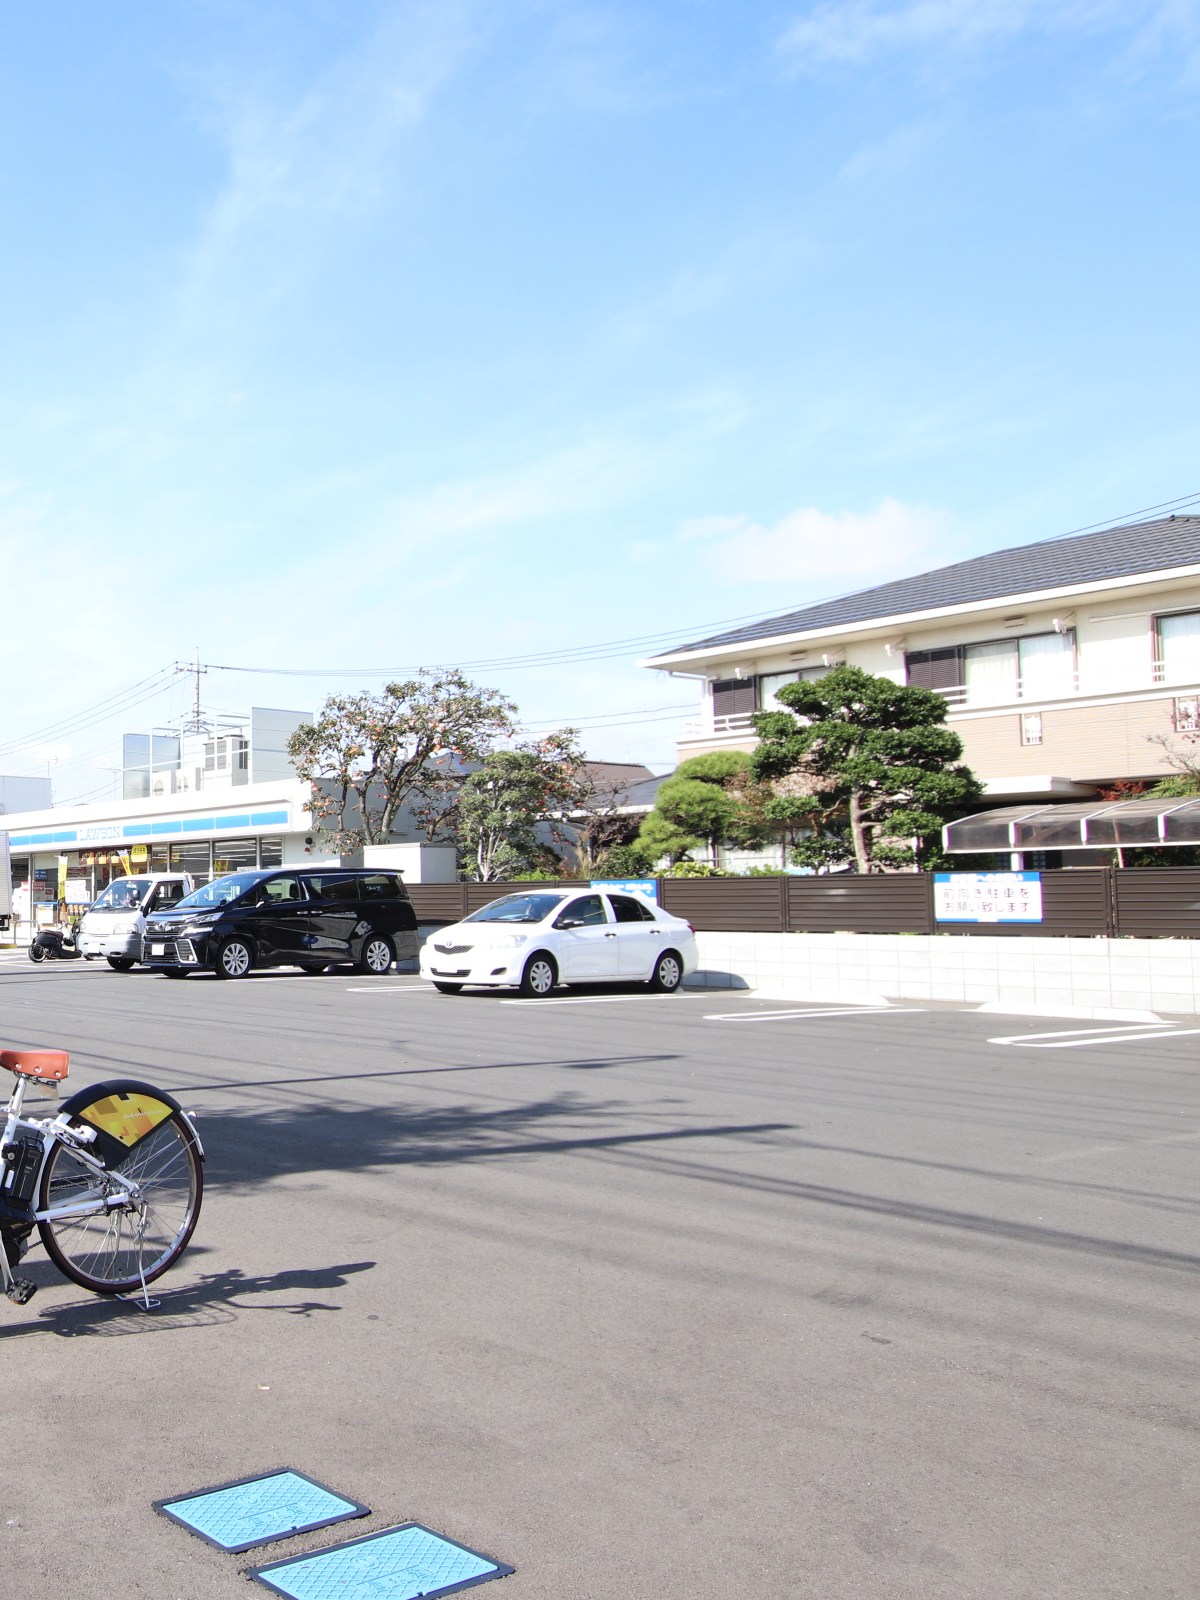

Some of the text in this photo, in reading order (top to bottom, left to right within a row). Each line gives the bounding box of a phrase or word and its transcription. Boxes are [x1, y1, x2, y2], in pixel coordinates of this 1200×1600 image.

[79, 826, 121, 841] LAWSON
[943, 887, 1030, 899] 前向き駐車を
[944, 901, 1030, 913] お願い致します
